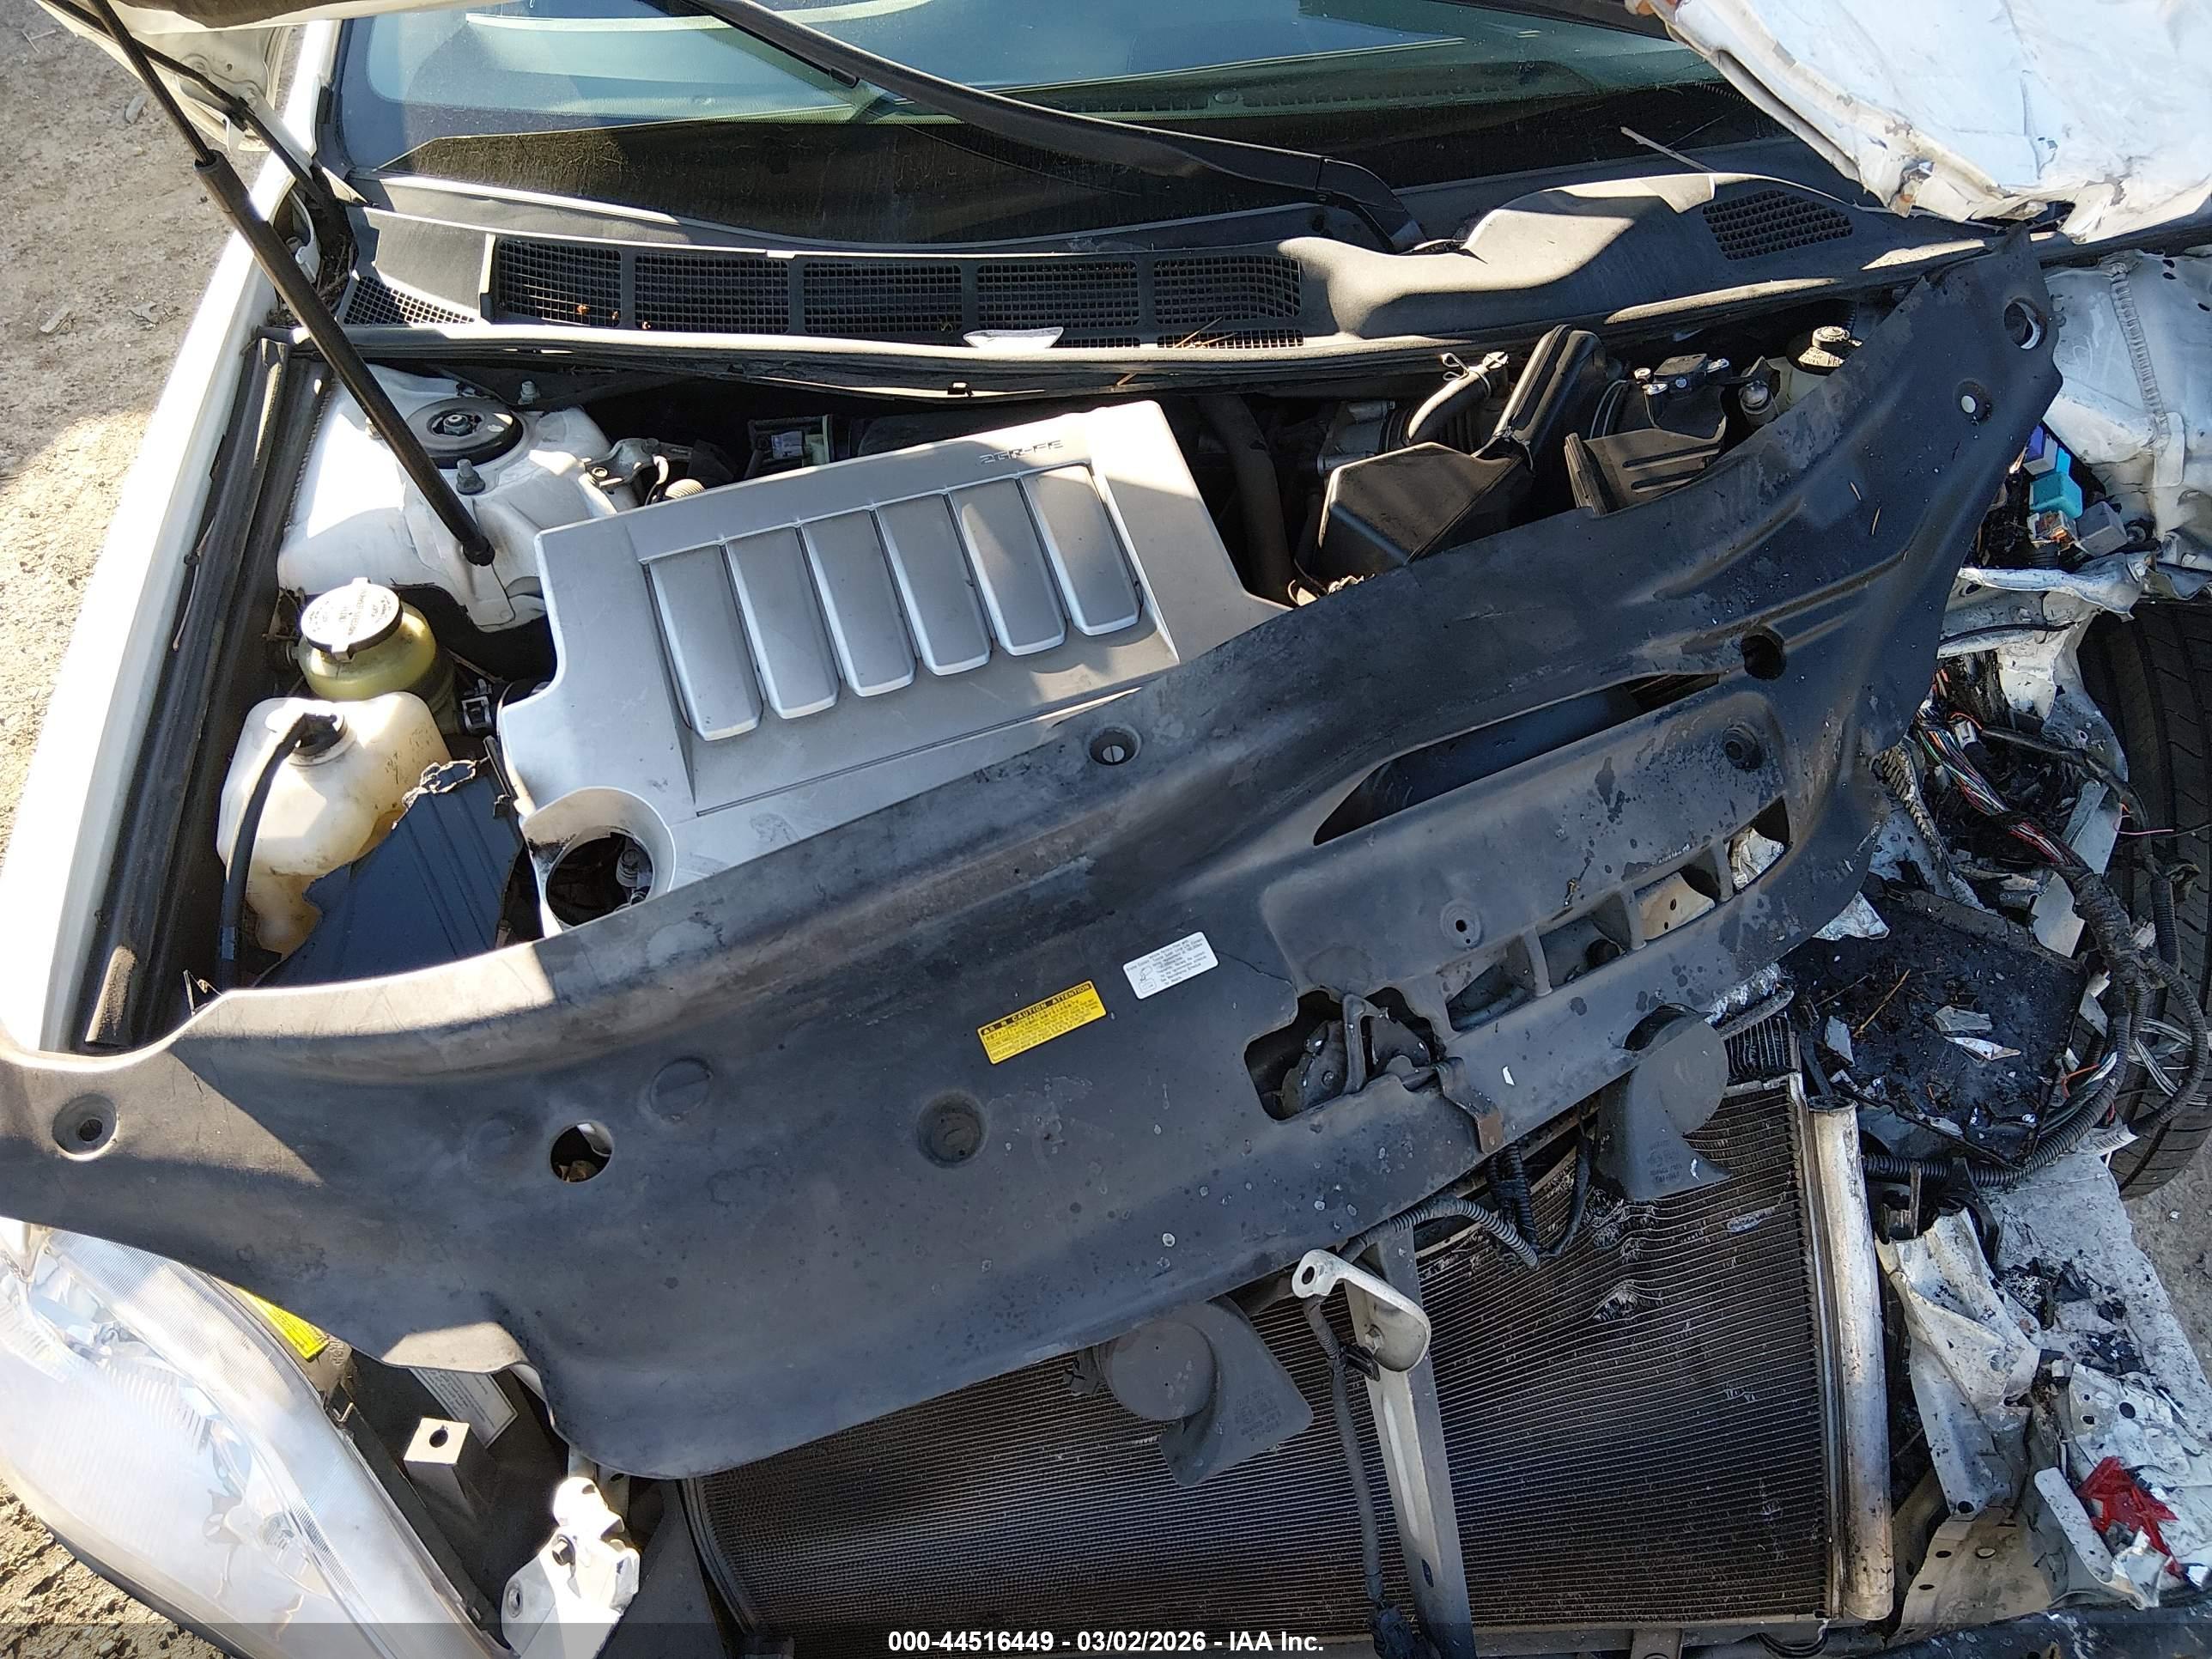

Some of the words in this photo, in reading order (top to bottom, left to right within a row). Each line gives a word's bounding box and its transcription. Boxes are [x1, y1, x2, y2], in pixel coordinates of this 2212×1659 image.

[979, 440, 1064, 464] 2GR-FE
[1012, 1002, 1047, 1022] CAUTION
[1052, 984, 1091, 1005] ATTENTION
